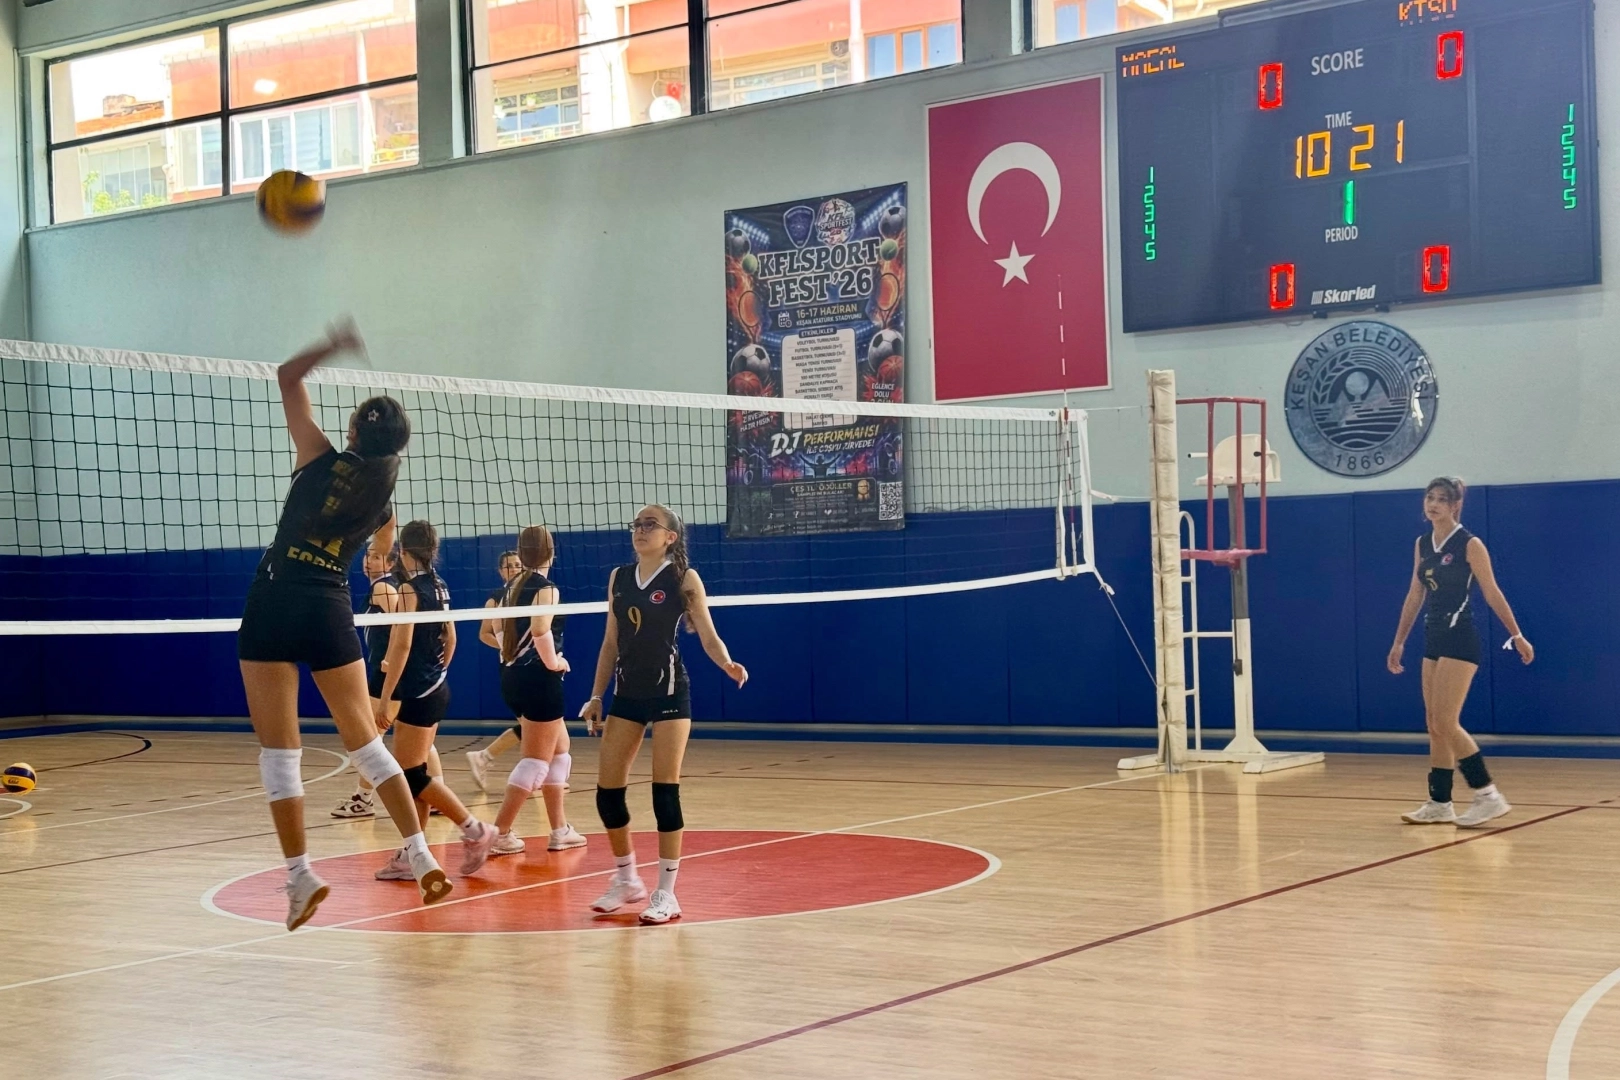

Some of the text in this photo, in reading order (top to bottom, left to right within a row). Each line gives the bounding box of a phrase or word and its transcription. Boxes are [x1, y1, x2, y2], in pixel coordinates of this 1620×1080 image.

[1311, 48, 1364, 76] SCORE
[1436, 30, 1464, 81] 0
[1257, 62, 1284, 109] 0
[1325, 111, 1352, 128] TIME
[1343, 180, 1355, 225] 1
[1325, 226, 1359, 244] PERIOD
[1422, 244, 1451, 294] 0
[768, 275, 830, 307] FEST
[1269, 262, 1296, 310] 0
[1324, 284, 1376, 305] Skorled
[796, 303, 858, 319] 16-17 HAZİRAN
[1291, 342, 1328, 410] KEŞAN
[1333, 328, 1433, 400] BELEDİYESİ
[770, 431, 802, 458] DJ
[1335, 452, 1385, 471] 1866
[627, 606, 643, 636] 9
